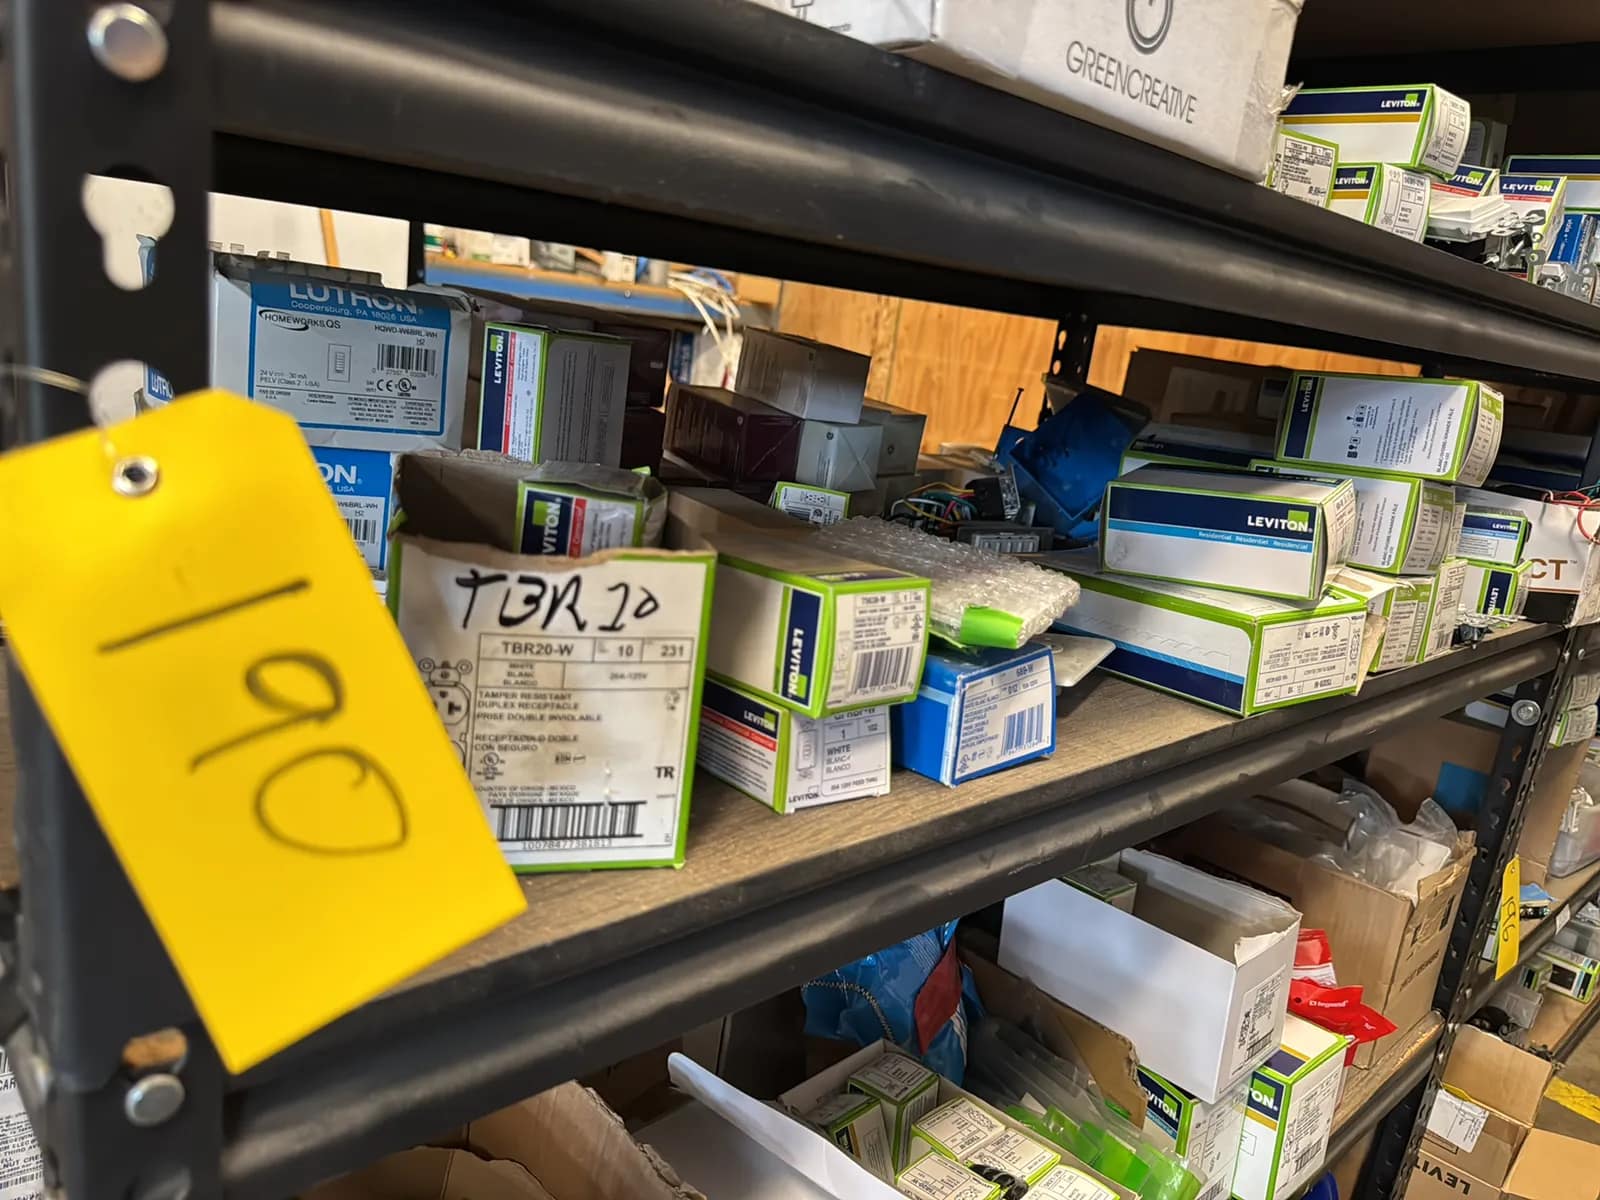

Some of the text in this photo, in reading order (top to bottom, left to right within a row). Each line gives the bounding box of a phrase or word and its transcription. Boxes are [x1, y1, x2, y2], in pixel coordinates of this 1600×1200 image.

[1066, 40, 1197, 124] GREENCREATIVE
[1380, 97, 1418, 108] LEVITON
[1335, 175, 1368, 185] LEVITON
[1502, 183, 1552, 193] LEVITON
[290, 283, 417, 314] LUTRON
[291, 300, 352, 317] Coopersburg,
[356, 309, 368, 318] PA
[400, 313, 416, 322] USA
[494, 334, 505, 384] LEVITON
[1301, 378, 1313, 413] LEVITON
[1247, 515, 1309, 533] LEVITON
[456, 569, 587, 632] TBR
[502, 641, 684, 657] TBR20-W 10 231
[788, 627, 805, 698] LEVITON
[479, 691, 572, 700] TAMPER RESISTANT
[478, 701, 579, 710] DUPLEX RECEPTACLE
[98, 576, 410, 858] 190
[507, 713, 544, 721] DOUBLE
[743, 710, 776, 732] LEVITON
[547, 734, 578, 742] DOBLE
[826, 744, 851, 756] WHITE
[655, 766, 675, 779] TR
[788, 792, 820, 803] LEVITON
